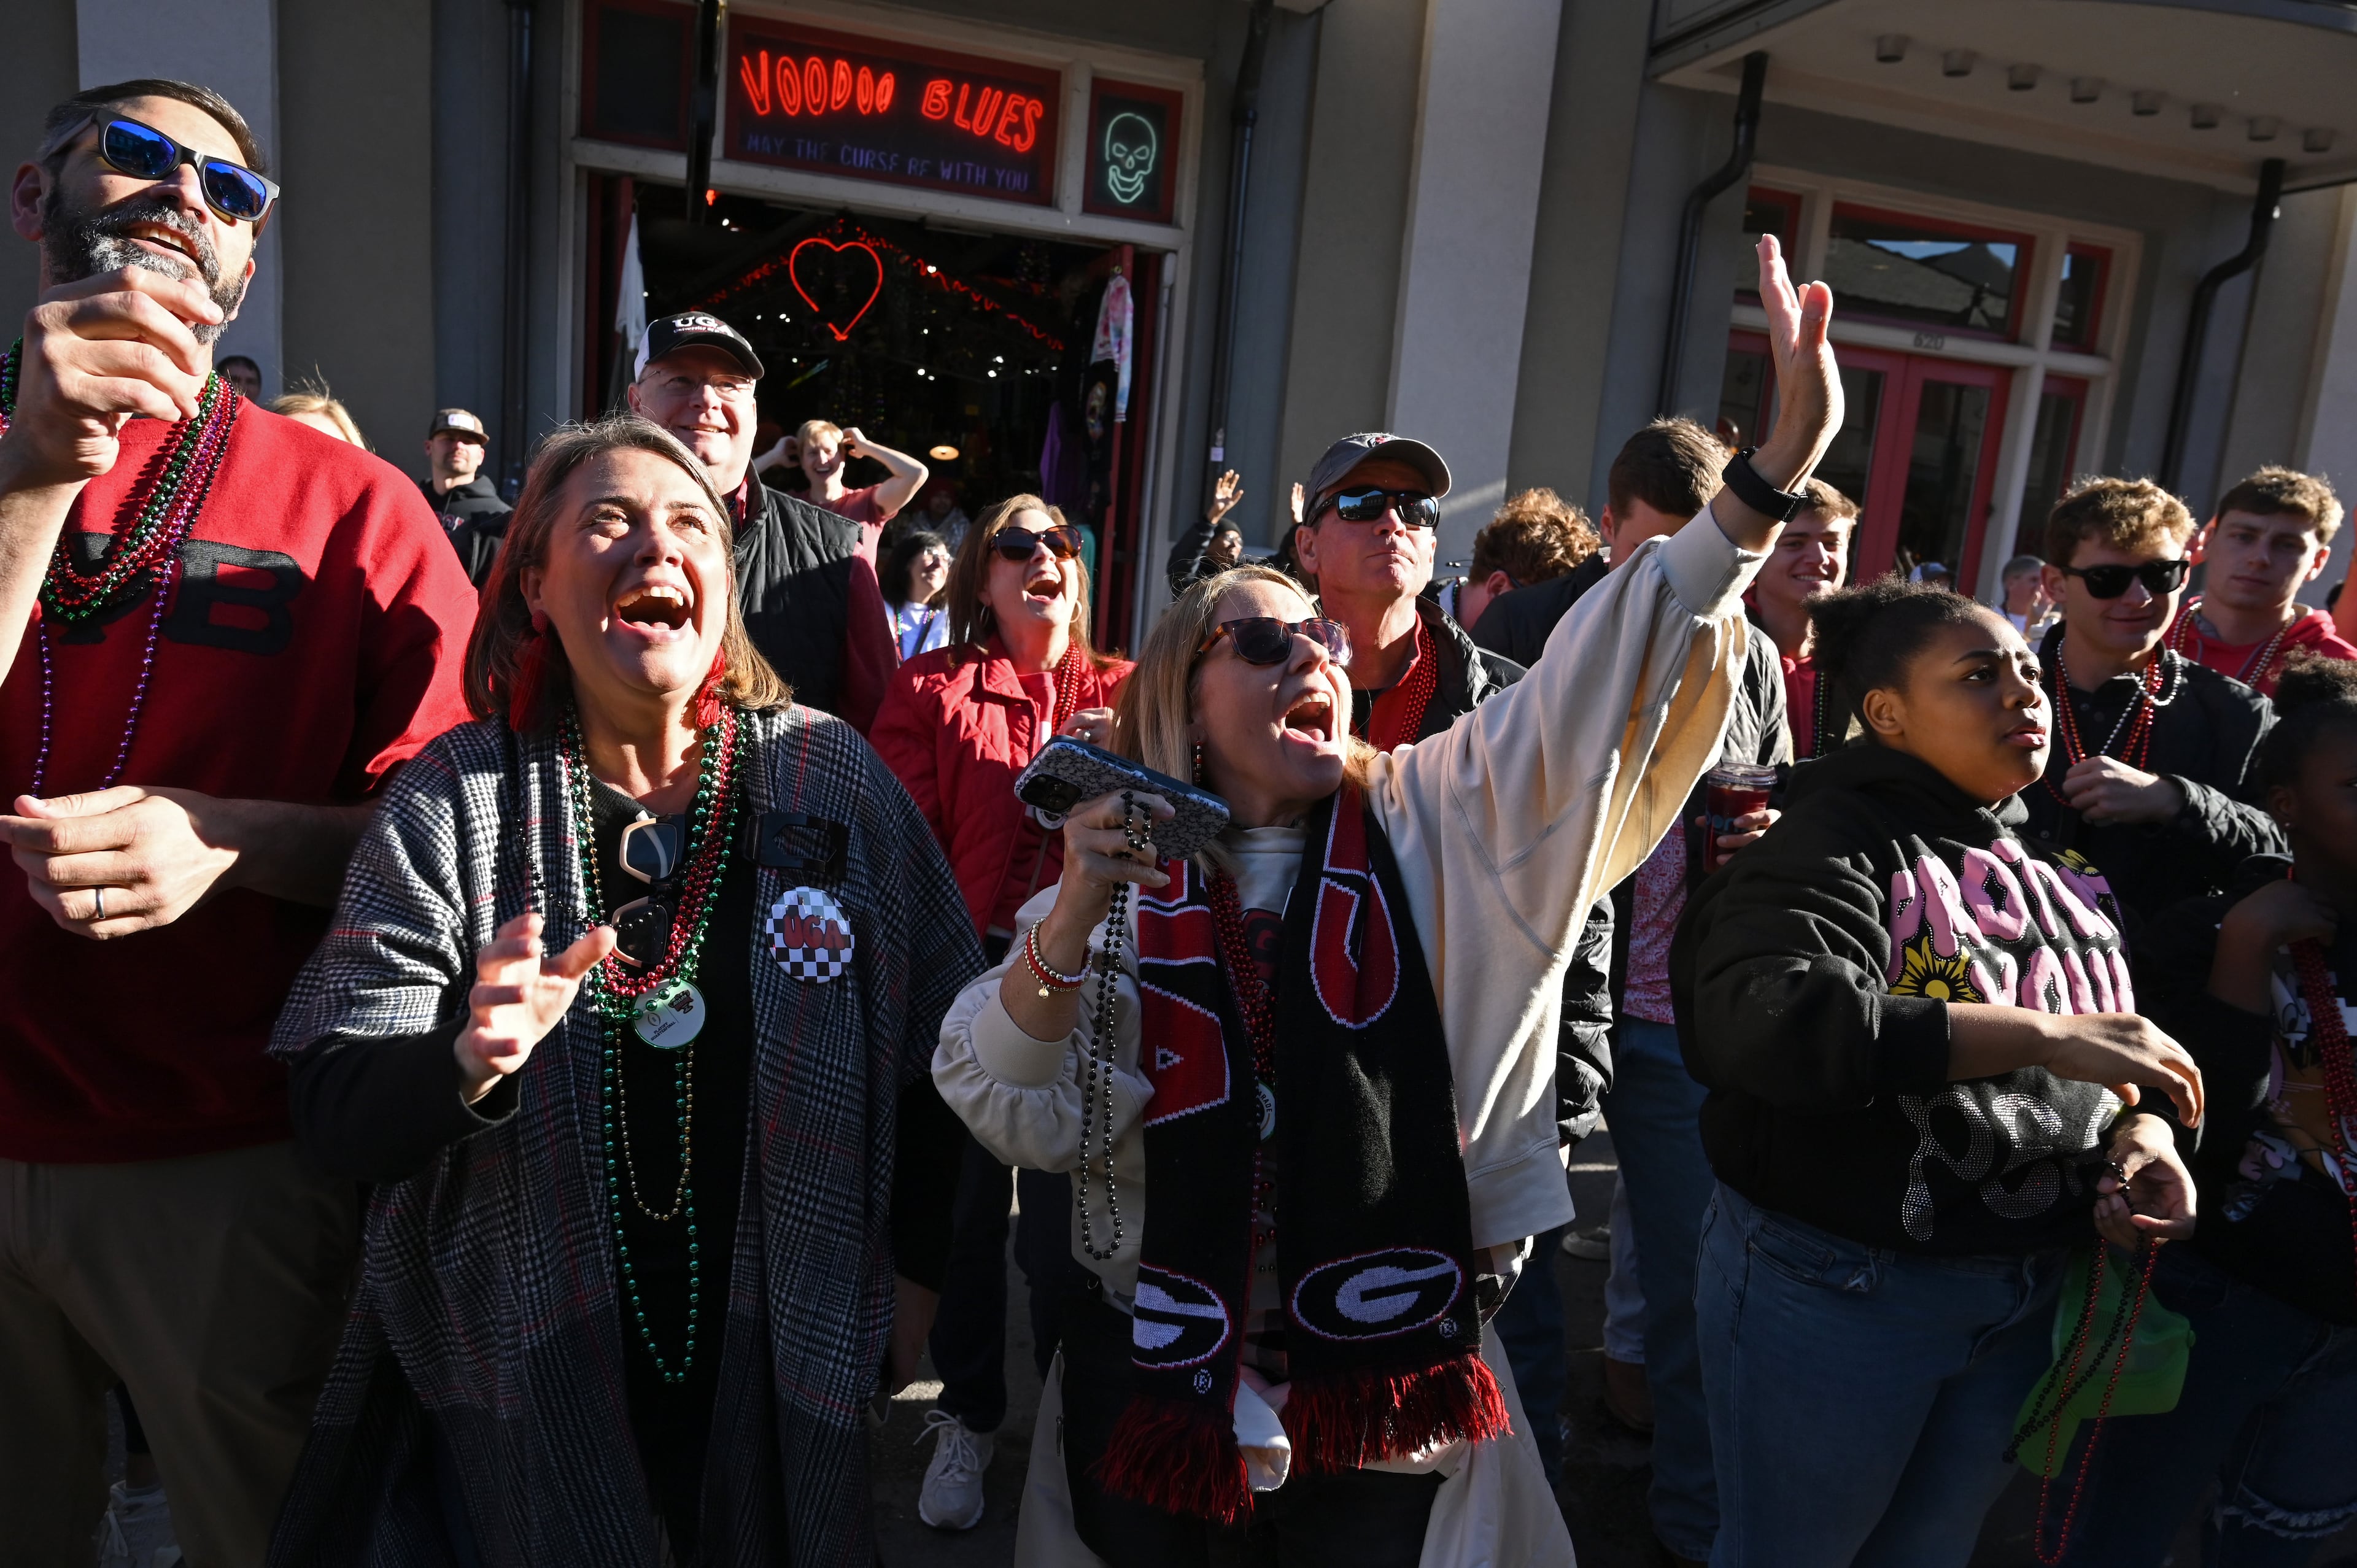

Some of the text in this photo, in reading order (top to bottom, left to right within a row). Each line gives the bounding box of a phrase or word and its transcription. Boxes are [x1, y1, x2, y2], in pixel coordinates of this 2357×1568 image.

[740, 51, 1043, 152] VOODOO BLUES
[746, 132, 784, 156] MAY
[796, 138, 829, 162] THE
[840, 144, 899, 173] CURSE
[940, 159, 987, 186] WITH
[994, 168, 1029, 193] YOU
[672, 316, 735, 338] UGA
[1914, 333, 1945, 352] 620
[783, 914, 846, 951] UGA
